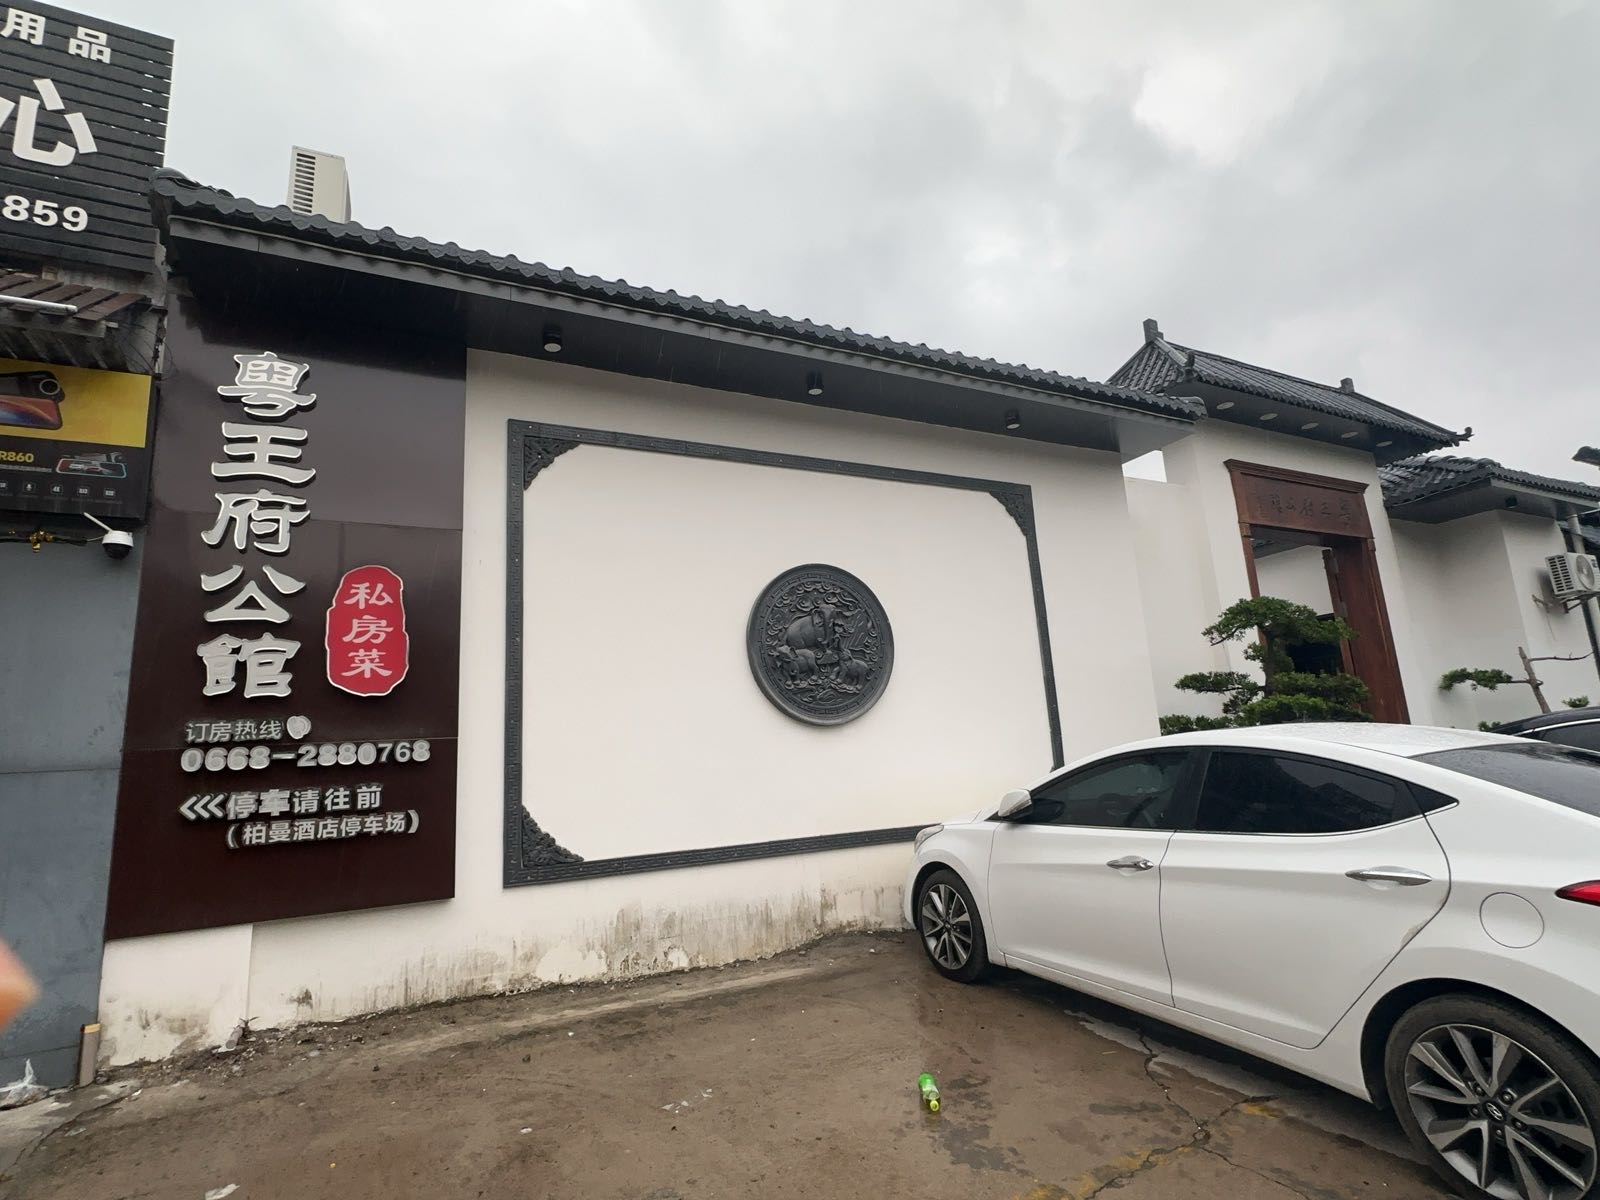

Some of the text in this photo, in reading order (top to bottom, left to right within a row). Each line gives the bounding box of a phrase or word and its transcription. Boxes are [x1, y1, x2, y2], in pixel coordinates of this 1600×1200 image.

[0, 8, 112, 64] 用品
[0, 78, 98, 167] 心
[2, 194, 89, 232] 859
[342, 582, 394, 678] 私房菜
[186, 720, 283, 742] 订房热线
